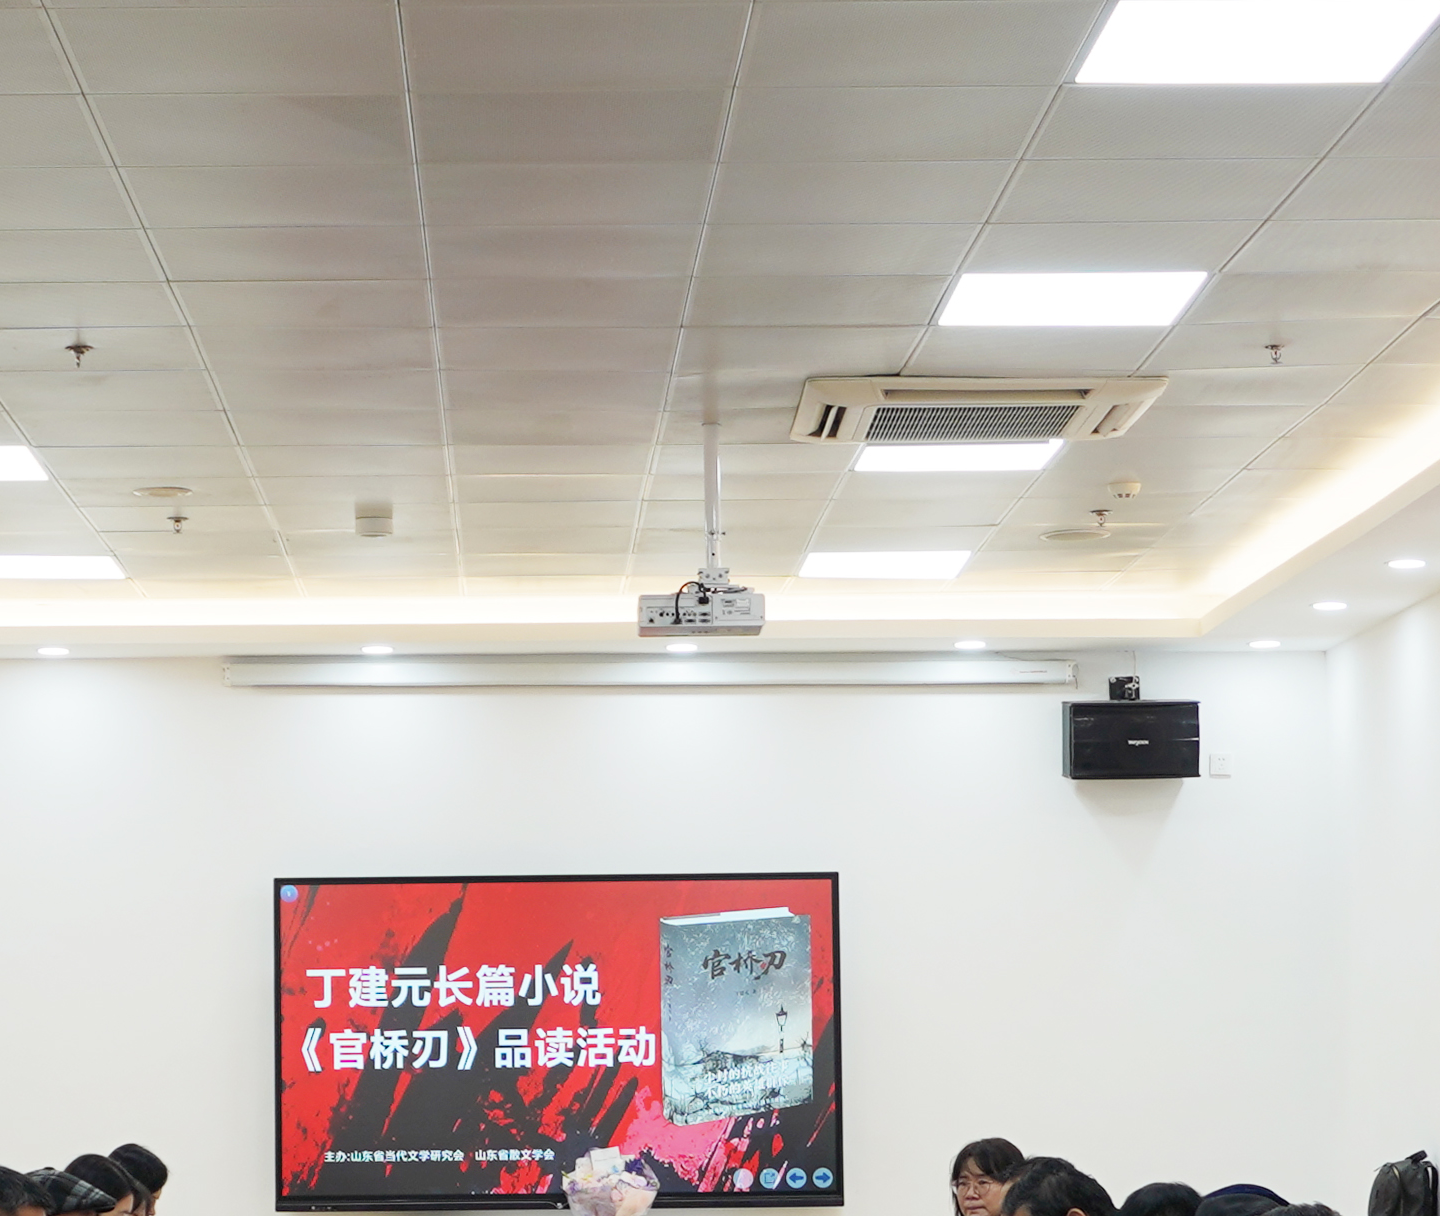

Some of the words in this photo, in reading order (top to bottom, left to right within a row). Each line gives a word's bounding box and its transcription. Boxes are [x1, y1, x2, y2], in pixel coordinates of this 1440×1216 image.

[702, 949, 787, 980] 官桥刃
[306, 964, 601, 1008] 丁建元长篇小说
[300, 1025, 657, 1073] 《官桥刃》品读活动
[475, 1149, 555, 1162] 山东省散文学会
